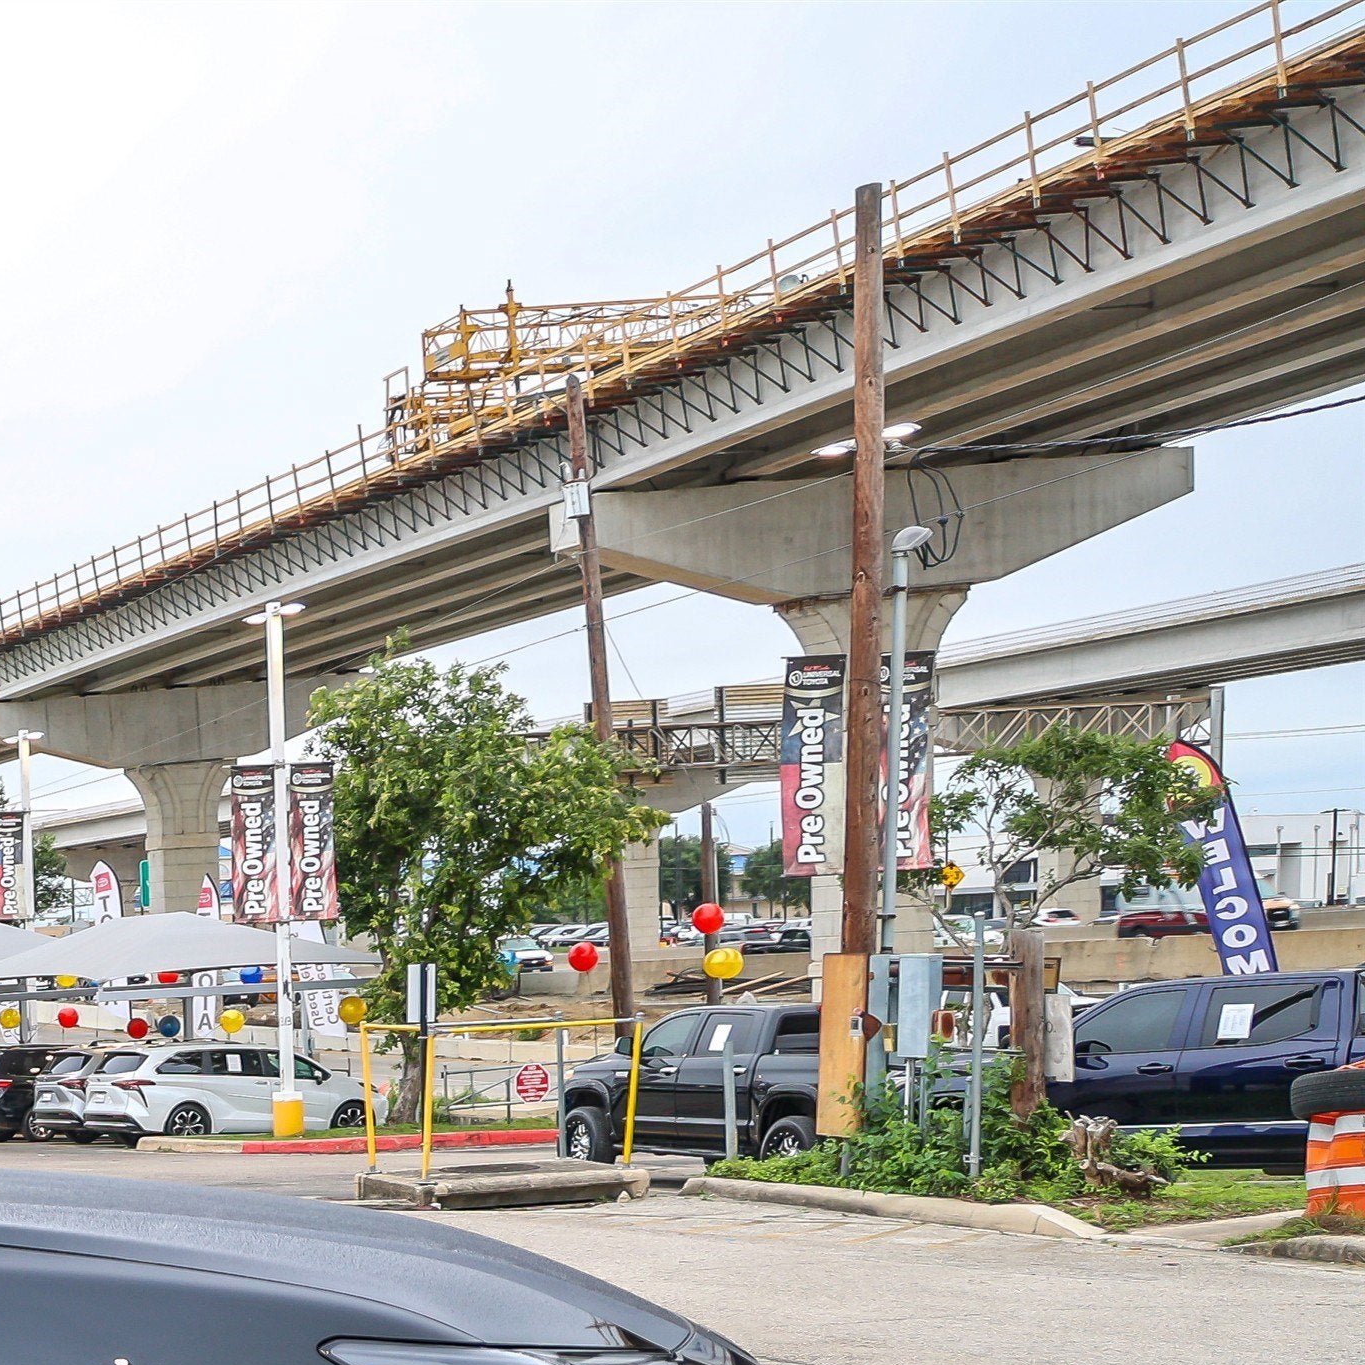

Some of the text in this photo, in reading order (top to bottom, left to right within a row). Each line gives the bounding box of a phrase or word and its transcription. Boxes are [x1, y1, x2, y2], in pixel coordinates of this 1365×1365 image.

[794, 707, 825, 811] Owned
[240, 801, 263, 876] Owned
[299, 799, 321, 873] Owned
[796, 814, 826, 865] Pre
[0, 836, 16, 889] Owned
[2, 890, 19, 916] Pre
[244, 878, 266, 915] Pre
[302, 875, 324, 912] Pre
